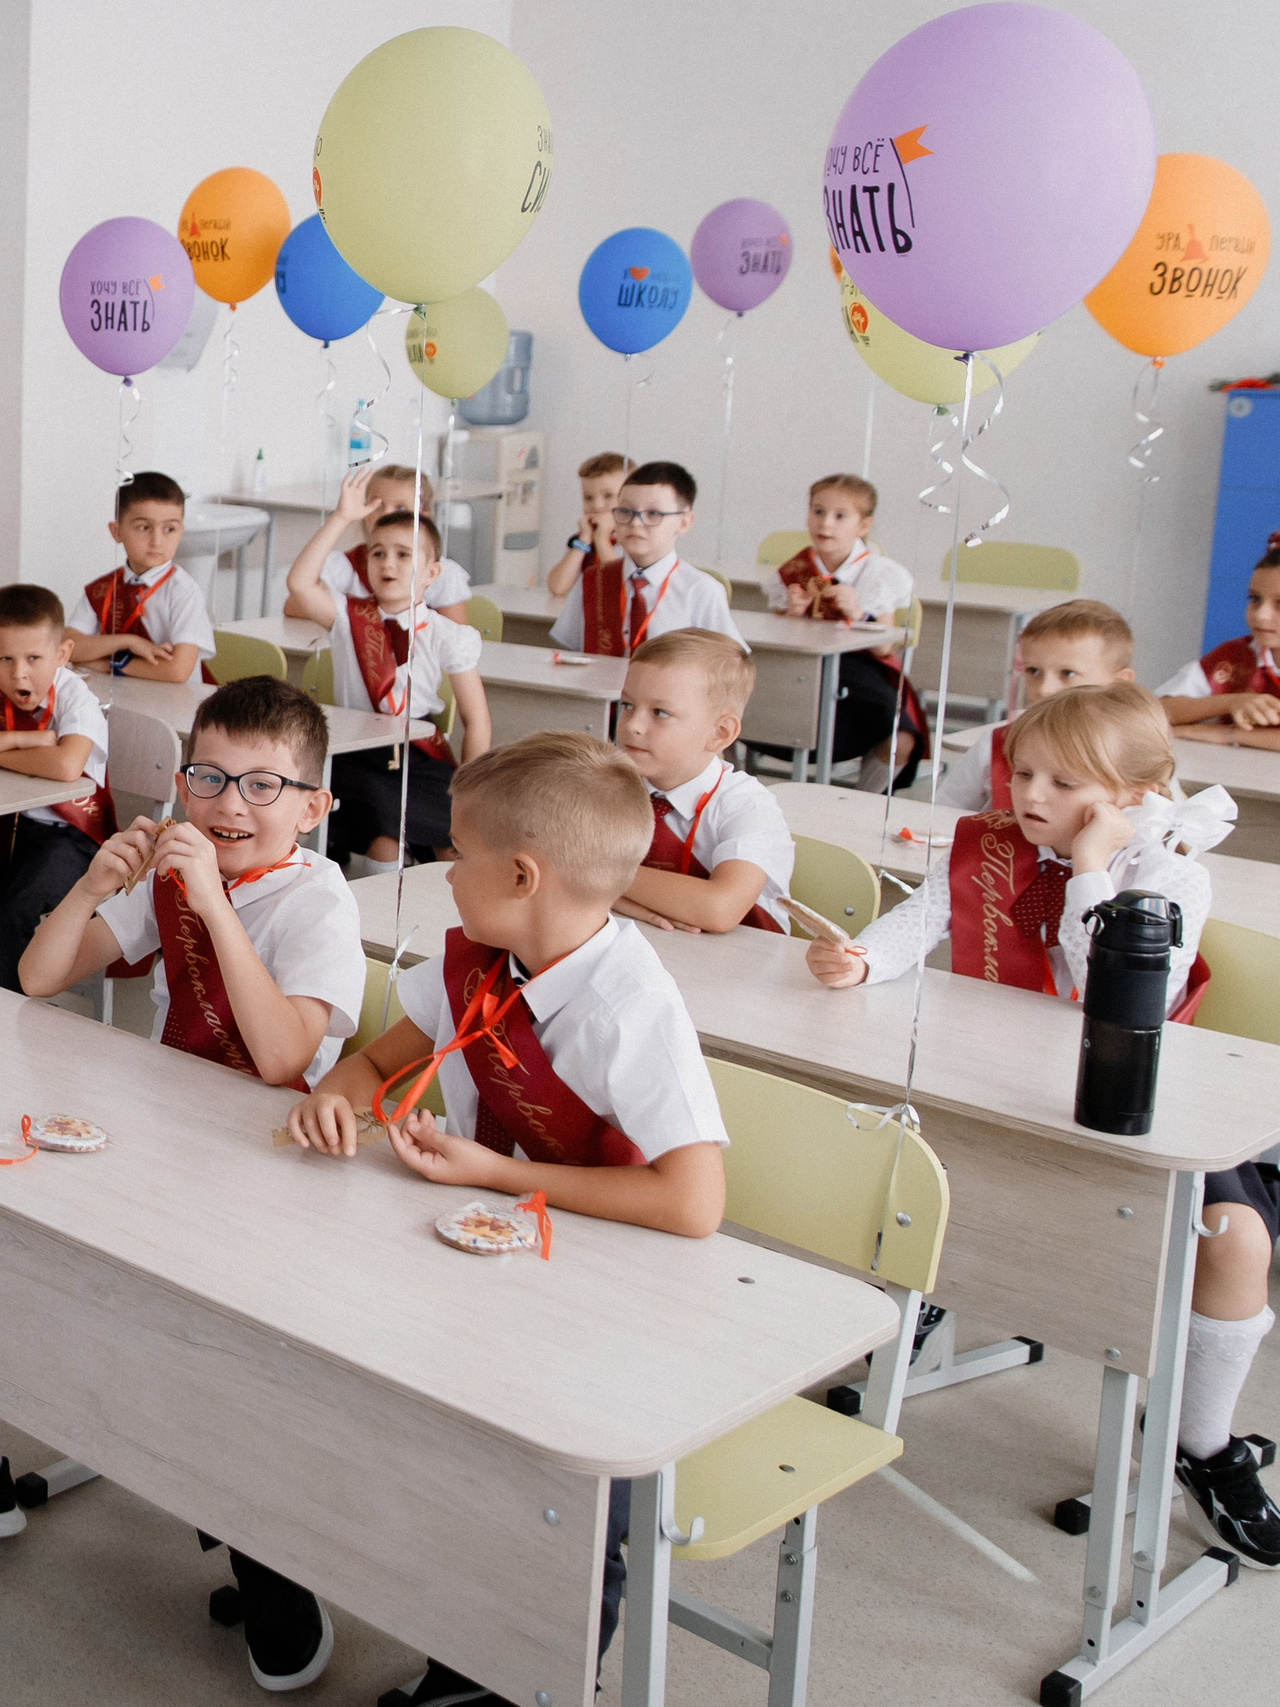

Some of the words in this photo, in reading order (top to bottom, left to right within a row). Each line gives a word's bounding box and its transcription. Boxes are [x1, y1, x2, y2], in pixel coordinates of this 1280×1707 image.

[823, 182, 913, 255] ЗНАТЬ
[181, 238, 231, 262] ВОНОК
[90, 280, 117, 295] ХОЧУ
[1149, 261, 1248, 300] ЗВОНОК
[617, 283, 679, 310] ШКОЛУ
[90, 298, 151, 332] ЗНАТЬ
